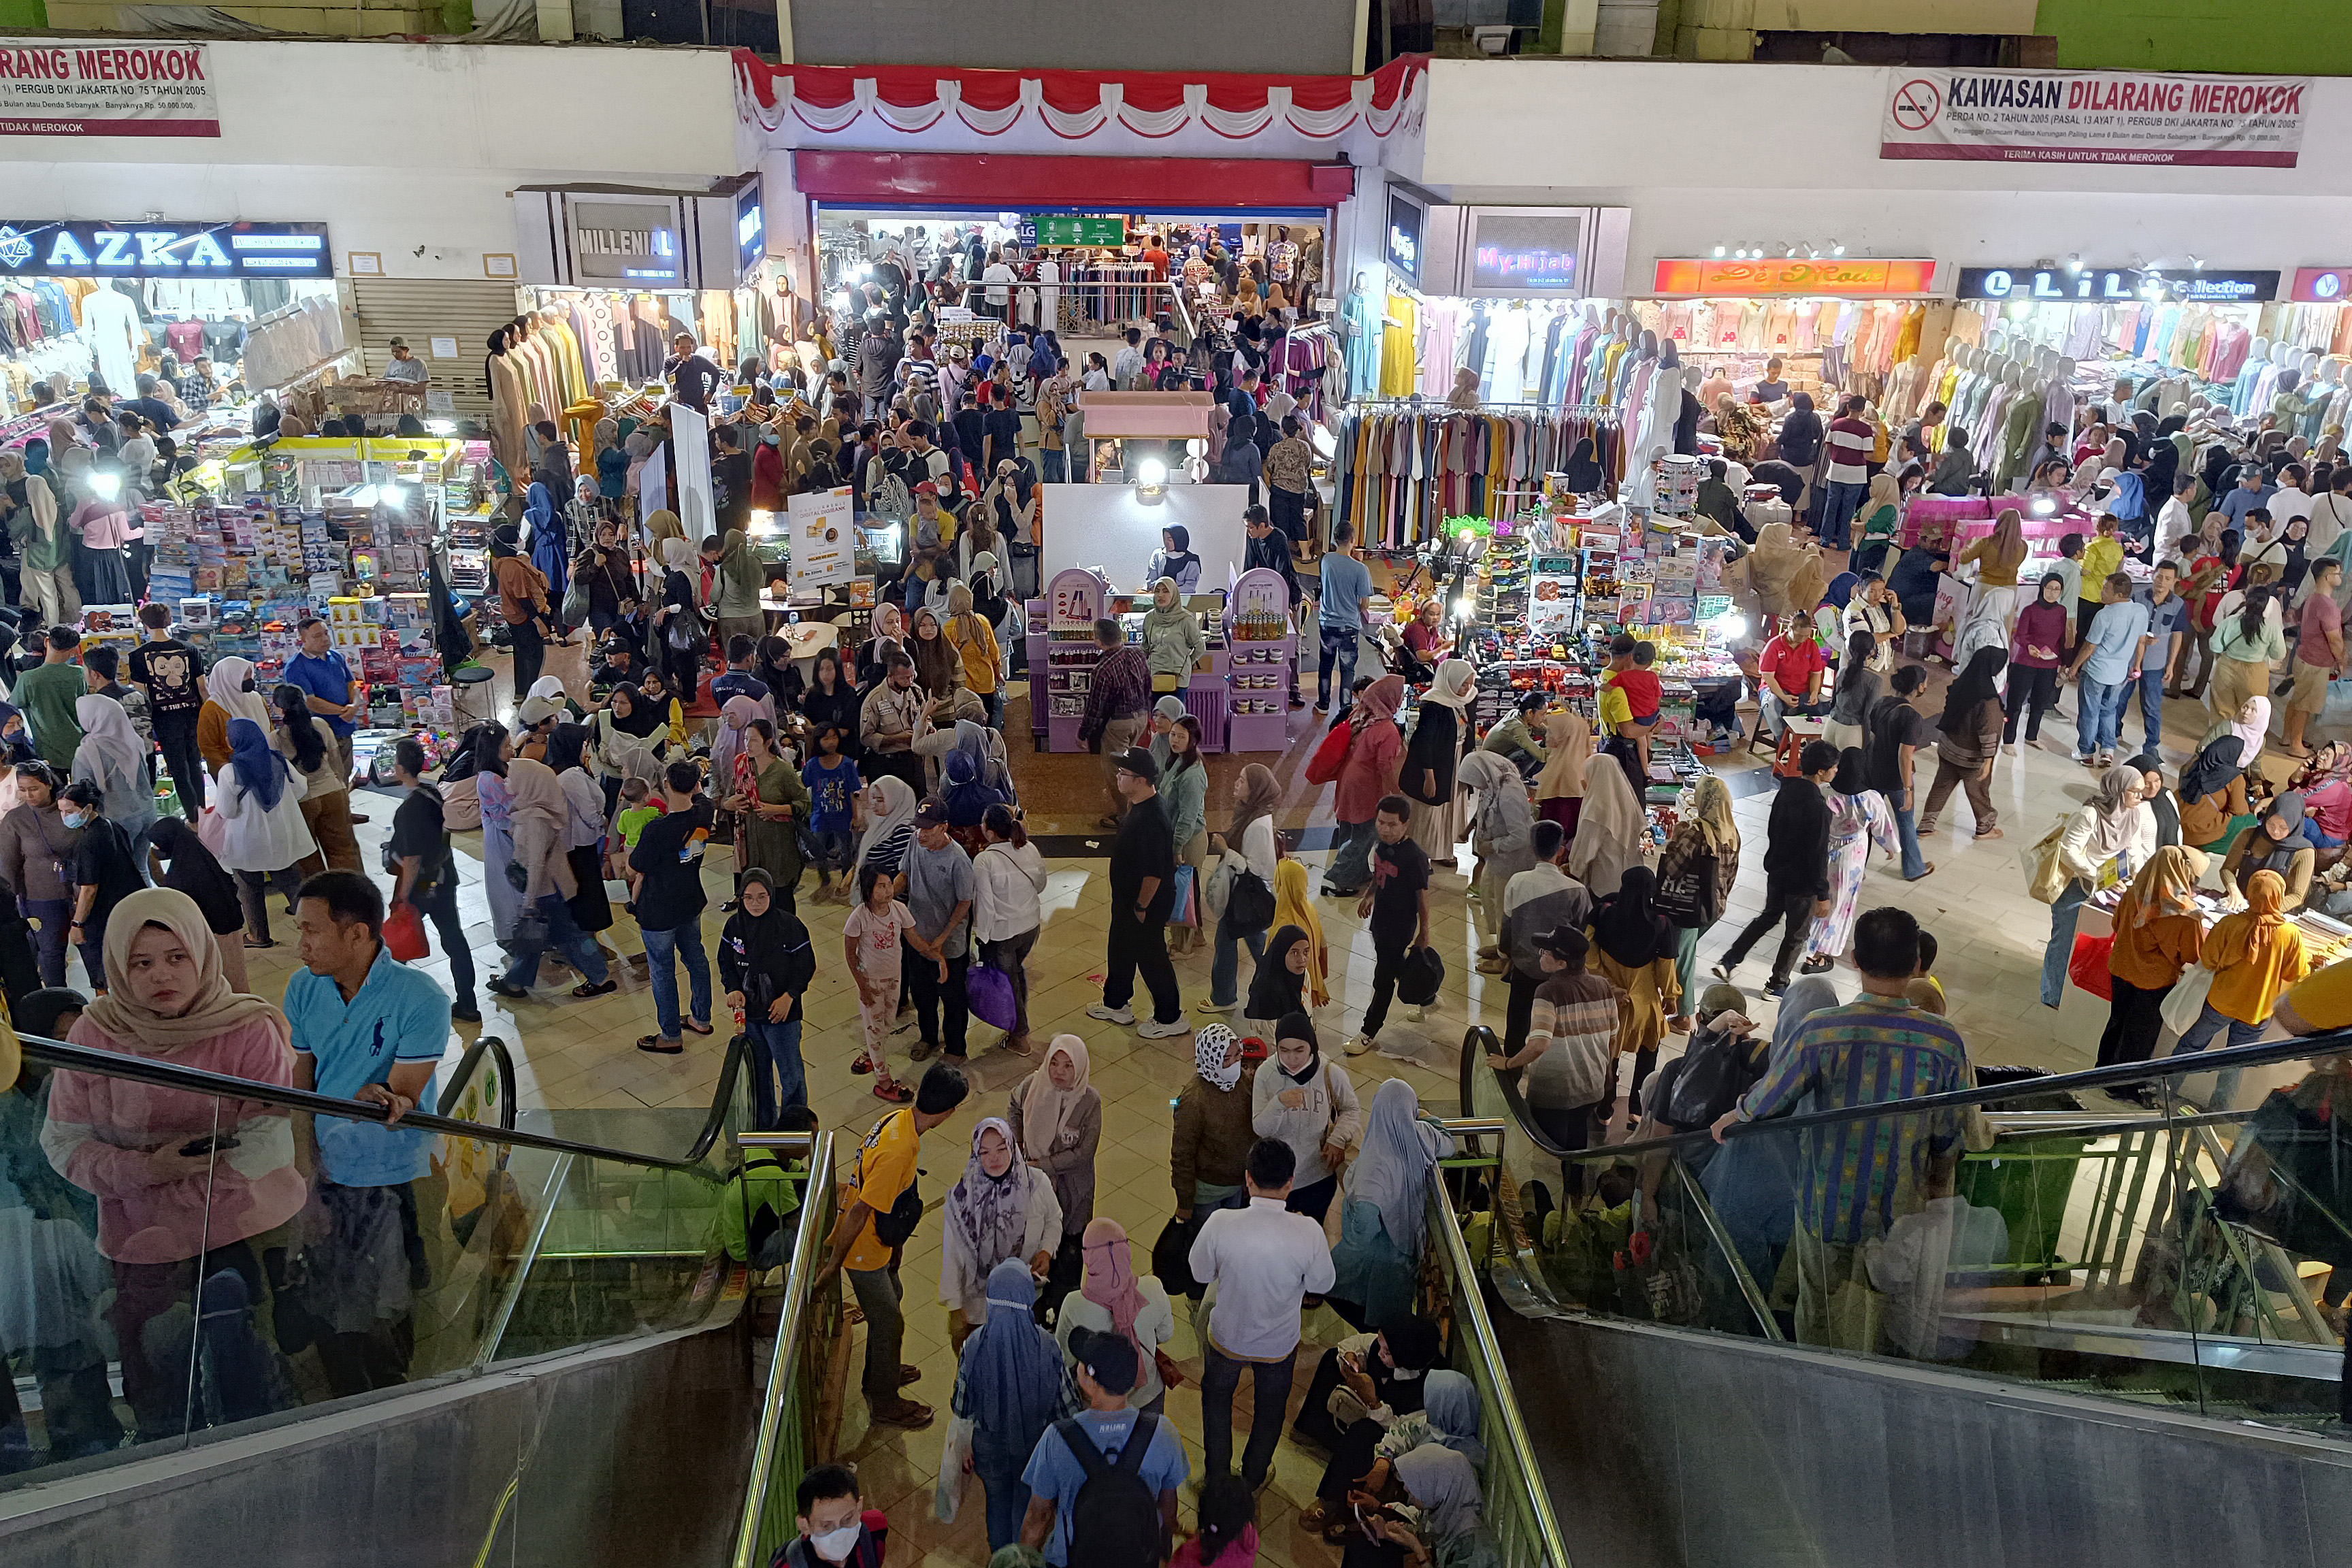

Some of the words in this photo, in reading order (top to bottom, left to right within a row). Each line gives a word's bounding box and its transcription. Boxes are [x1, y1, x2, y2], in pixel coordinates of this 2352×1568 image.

[0, 50, 69, 80] RANG
[75, 49, 206, 81] MEROKOK
[15, 84, 54, 94] PERGUB
[57, 84, 74, 94] DKI
[76, 84, 118, 95] JAKARTA
[139, 86, 149, 94] 75
[151, 86, 183, 95] TAHUN
[184, 86, 206, 95] 2005
[1947, 78, 2062, 109] KAWASAN
[2068, 81, 2184, 112] DILARANG
[2189, 84, 2306, 114] MEROKOK
[1, 122, 31, 132] TIDAK
[32, 123, 84, 133] MEROKOK
[1946, 111, 1974, 121] PERDA
[1976, 112, 1991, 122] NO.
[1993, 113, 1999, 122] 2
[2000, 113, 2029, 123] TAHUN
[2030, 114, 2049, 123] 2005
[2051, 114, 2080, 125] (PASAL
[2084, 116, 2093, 125] 13
[2093, 116, 2114, 125] AYAT
[2127, 116, 2163, 127] PERGUB
[2164, 117, 2180, 127] DKI
[2180, 118, 2219, 127] JAKARTA
[2221, 119, 2234, 128] NO.
[2249, 119, 2277, 128] TAHUN
[2278, 120, 2296, 129] 2005
[2004, 150, 2036, 159] TERIMA
[2038, 150, 2066, 160] KASIH
[2068, 151, 2098, 161] UNTUK
[2101, 152, 2127, 162] TIDAK
[2129, 152, 2175, 163] MEROKOK
[1021, 225, 1036, 238] LG
[46, 230, 233, 267] AZKA
[578, 228, 674, 257] MILLENIAL
[2173, 279, 2257, 295] Collection
